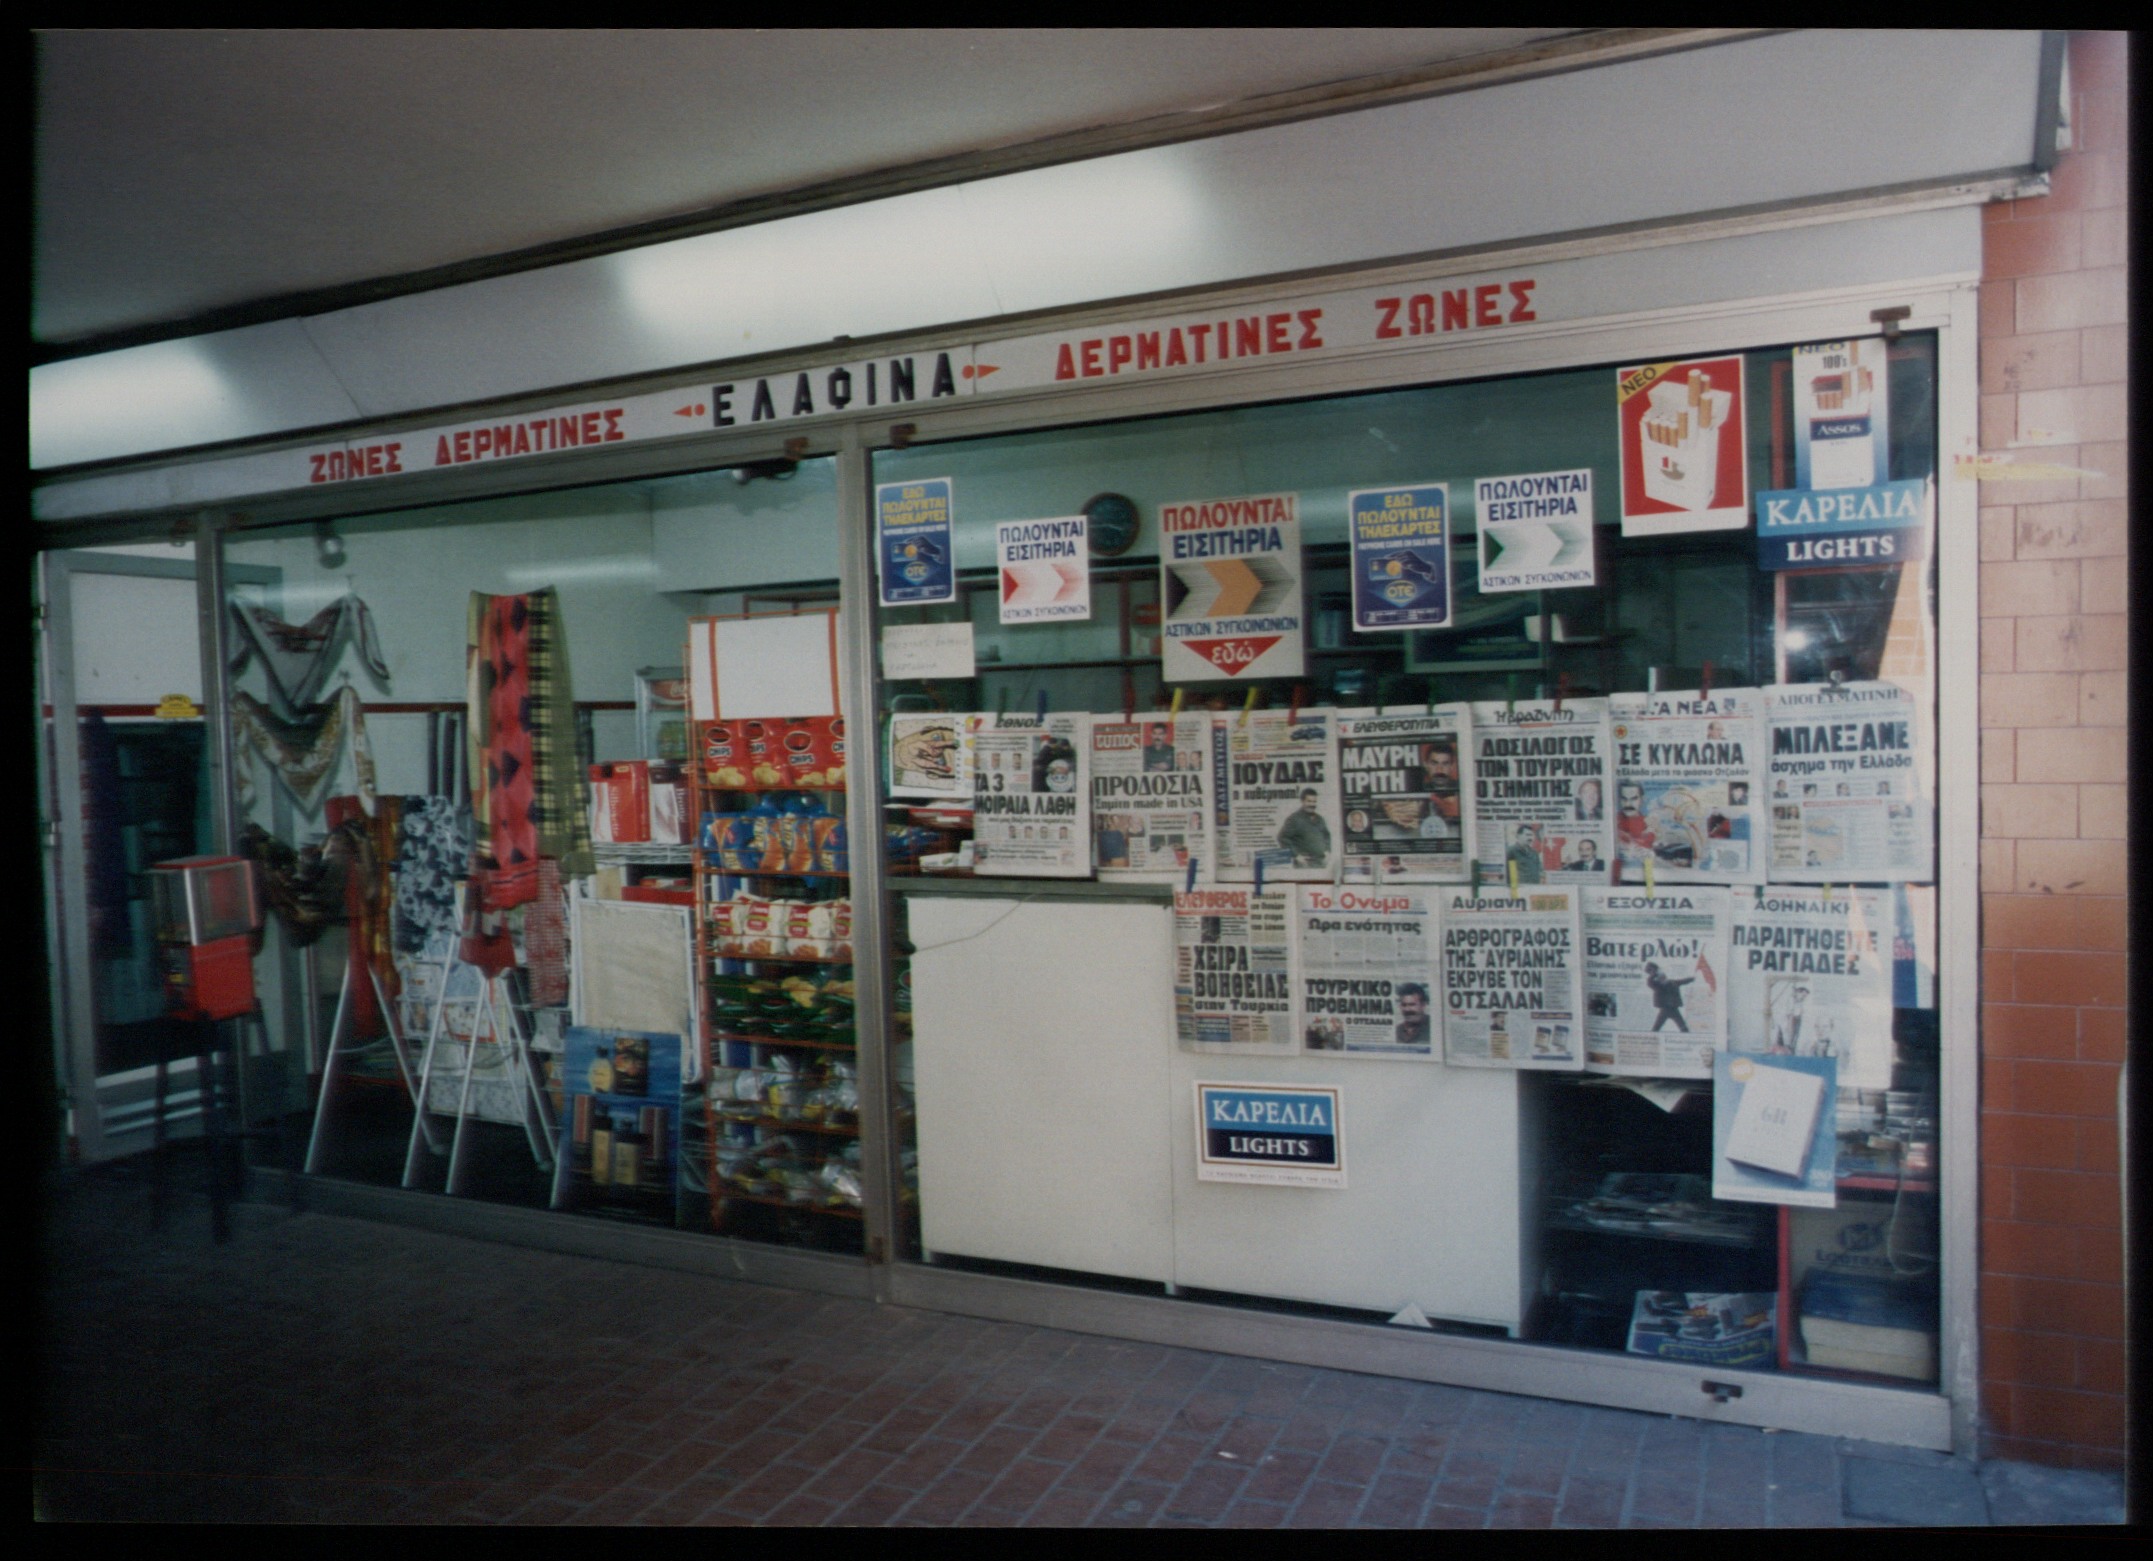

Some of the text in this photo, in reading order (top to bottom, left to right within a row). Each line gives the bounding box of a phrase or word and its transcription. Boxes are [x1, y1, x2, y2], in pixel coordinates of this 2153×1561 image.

[1056, 280, 1537, 381] ΔΕΡΜΑΤΙΝΕΣ ΖΩΝΕΣ
[713, 352, 956, 427] ΕΛΑΦΙΝΑ
[1621, 367, 1656, 396] ΝΕΟ
[310, 408, 626, 484] ΖΩΝΕΣ ΔΕΡΜΑΤΙΝΕΣ
[1480, 473, 1588, 502] ΠΩΛΟΥΝΤΑΙ
[1384, 493, 1413, 508] ΕΔΩ
[1488, 497, 1578, 522] ΕΙΣΙΤΗΡΙΑ
[1766, 484, 1918, 526] ΚΑΡΕΛΙΑ
[1163, 497, 1295, 533] ΠΩΛΟΥΝΤΑΙ
[1358, 506, 1441, 525] ΠΩΛΟΥΝΤΑΙ
[1000, 521, 1084, 544] ΠΩΛΟΥΝΤΑΙ
[1358, 520, 1441, 539] ΤΗΛΕΚΑΡΤΕΣ
[1006, 542, 1077, 562] ΕΙΣΙΤΗΡΙΑ
[1174, 526, 1283, 559] ΕΙΣΙΤΗΡΙΑ
[1787, 535, 1895, 562] LIGHTS
[1164, 622, 1213, 638] ΑΣΤΙΚΩΝ
[1676, 700, 1718, 716] ΝΕΑ
[1353, 718, 1440, 734] ΕΛΕΥΘΕΡΟΤΥΠΙΑ
[1481, 735, 1595, 757] ΔΟΣΙΛΟΓΟΣ
[1772, 721, 1910, 756] ΜΠΛΕΞΑΝΕ
[1342, 744, 1420, 770] ΜΑΥΡΗ
[1618, 742, 1744, 766] ΣΕ ΚΥΚΛΩΝΑ
[1771, 753, 1913, 776] άσχημα την Ελλάδα
[1232, 760, 1324, 785] ΙΟΥΔΑΣ
[1475, 757, 1602, 778] ΤΩΝ ΤΟΥΡΚΩΝ
[992, 773, 1004, 792] 3
[1094, 774, 1203, 797] ΠΡΟΔΟΣΙΑ
[1342, 769, 1406, 794] ΤΡΙΤΗ
[1475, 779, 1573, 798] Ο ΣΗΜΙΤΗΣ
[1034, 796, 1077, 816] ΛΑΘΗ
[1133, 797, 1164, 808] made
[1166, 797, 1178, 808] in
[1181, 796, 1204, 808] USA
[1309, 892, 1332, 909] Το
[1606, 896, 1694, 910] ΕΞΟΥΣΙΑ
[1344, 918, 1422, 935] ενότητας
[1445, 928, 1570, 948] ΑΡΘΡΟΓΡΑΦΟΣ
[1193, 945, 1249, 972] ΧΕΙΡΑ
[1446, 949, 1476, 968] ΤΗΣ
[1586, 937, 1699, 962] Βατερλώ!
[1748, 949, 1861, 976] ΡΑΓΙΑΔΕΣ
[1194, 972, 1289, 999] ΒΟΗΘΕΙΑΣ
[1304, 979, 1392, 998] ΤΟΥΡΚΙΚΟ
[1446, 970, 1543, 989] ΕΚΡΥΒΕ ΤΟΝ
[1305, 997, 1394, 1015] ΠΡΟΒΛΗΜΑ
[1448, 991, 1543, 1010] ΟΤΣΑΛΑΝ
[1212, 1099, 1327, 1126] ΚΑΡΕΛΙΑ
[1229, 1136, 1309, 1156] LIGHTS
